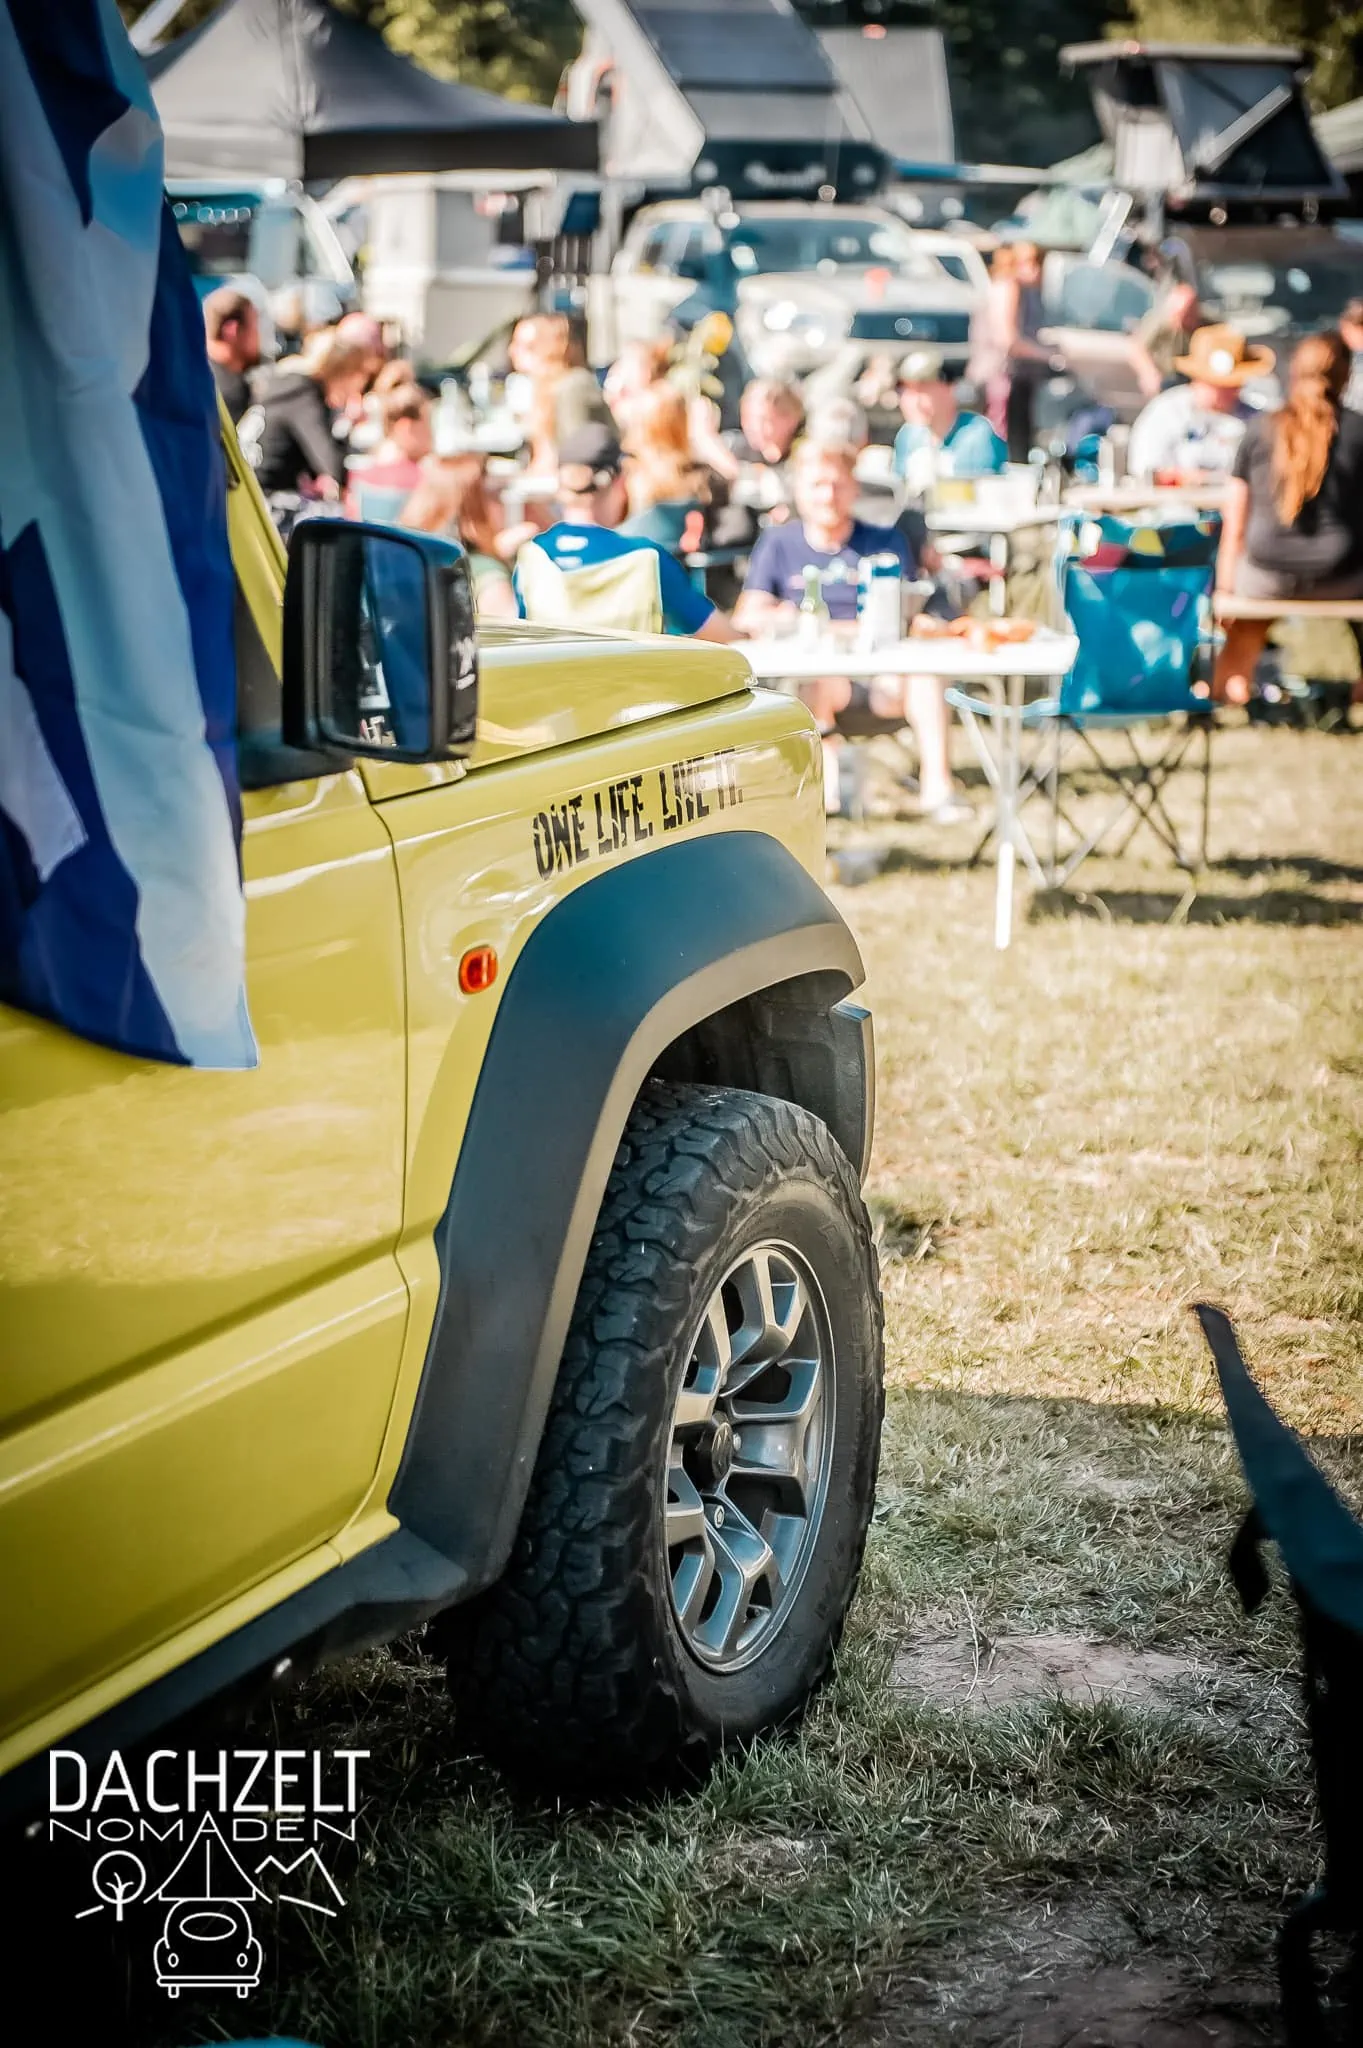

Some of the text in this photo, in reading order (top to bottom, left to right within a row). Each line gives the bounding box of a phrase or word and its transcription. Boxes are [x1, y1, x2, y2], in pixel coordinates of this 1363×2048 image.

[532, 794, 590, 880] ONE
[594, 775, 654, 855] LIFE.
[659, 756, 710, 831] LIVE
